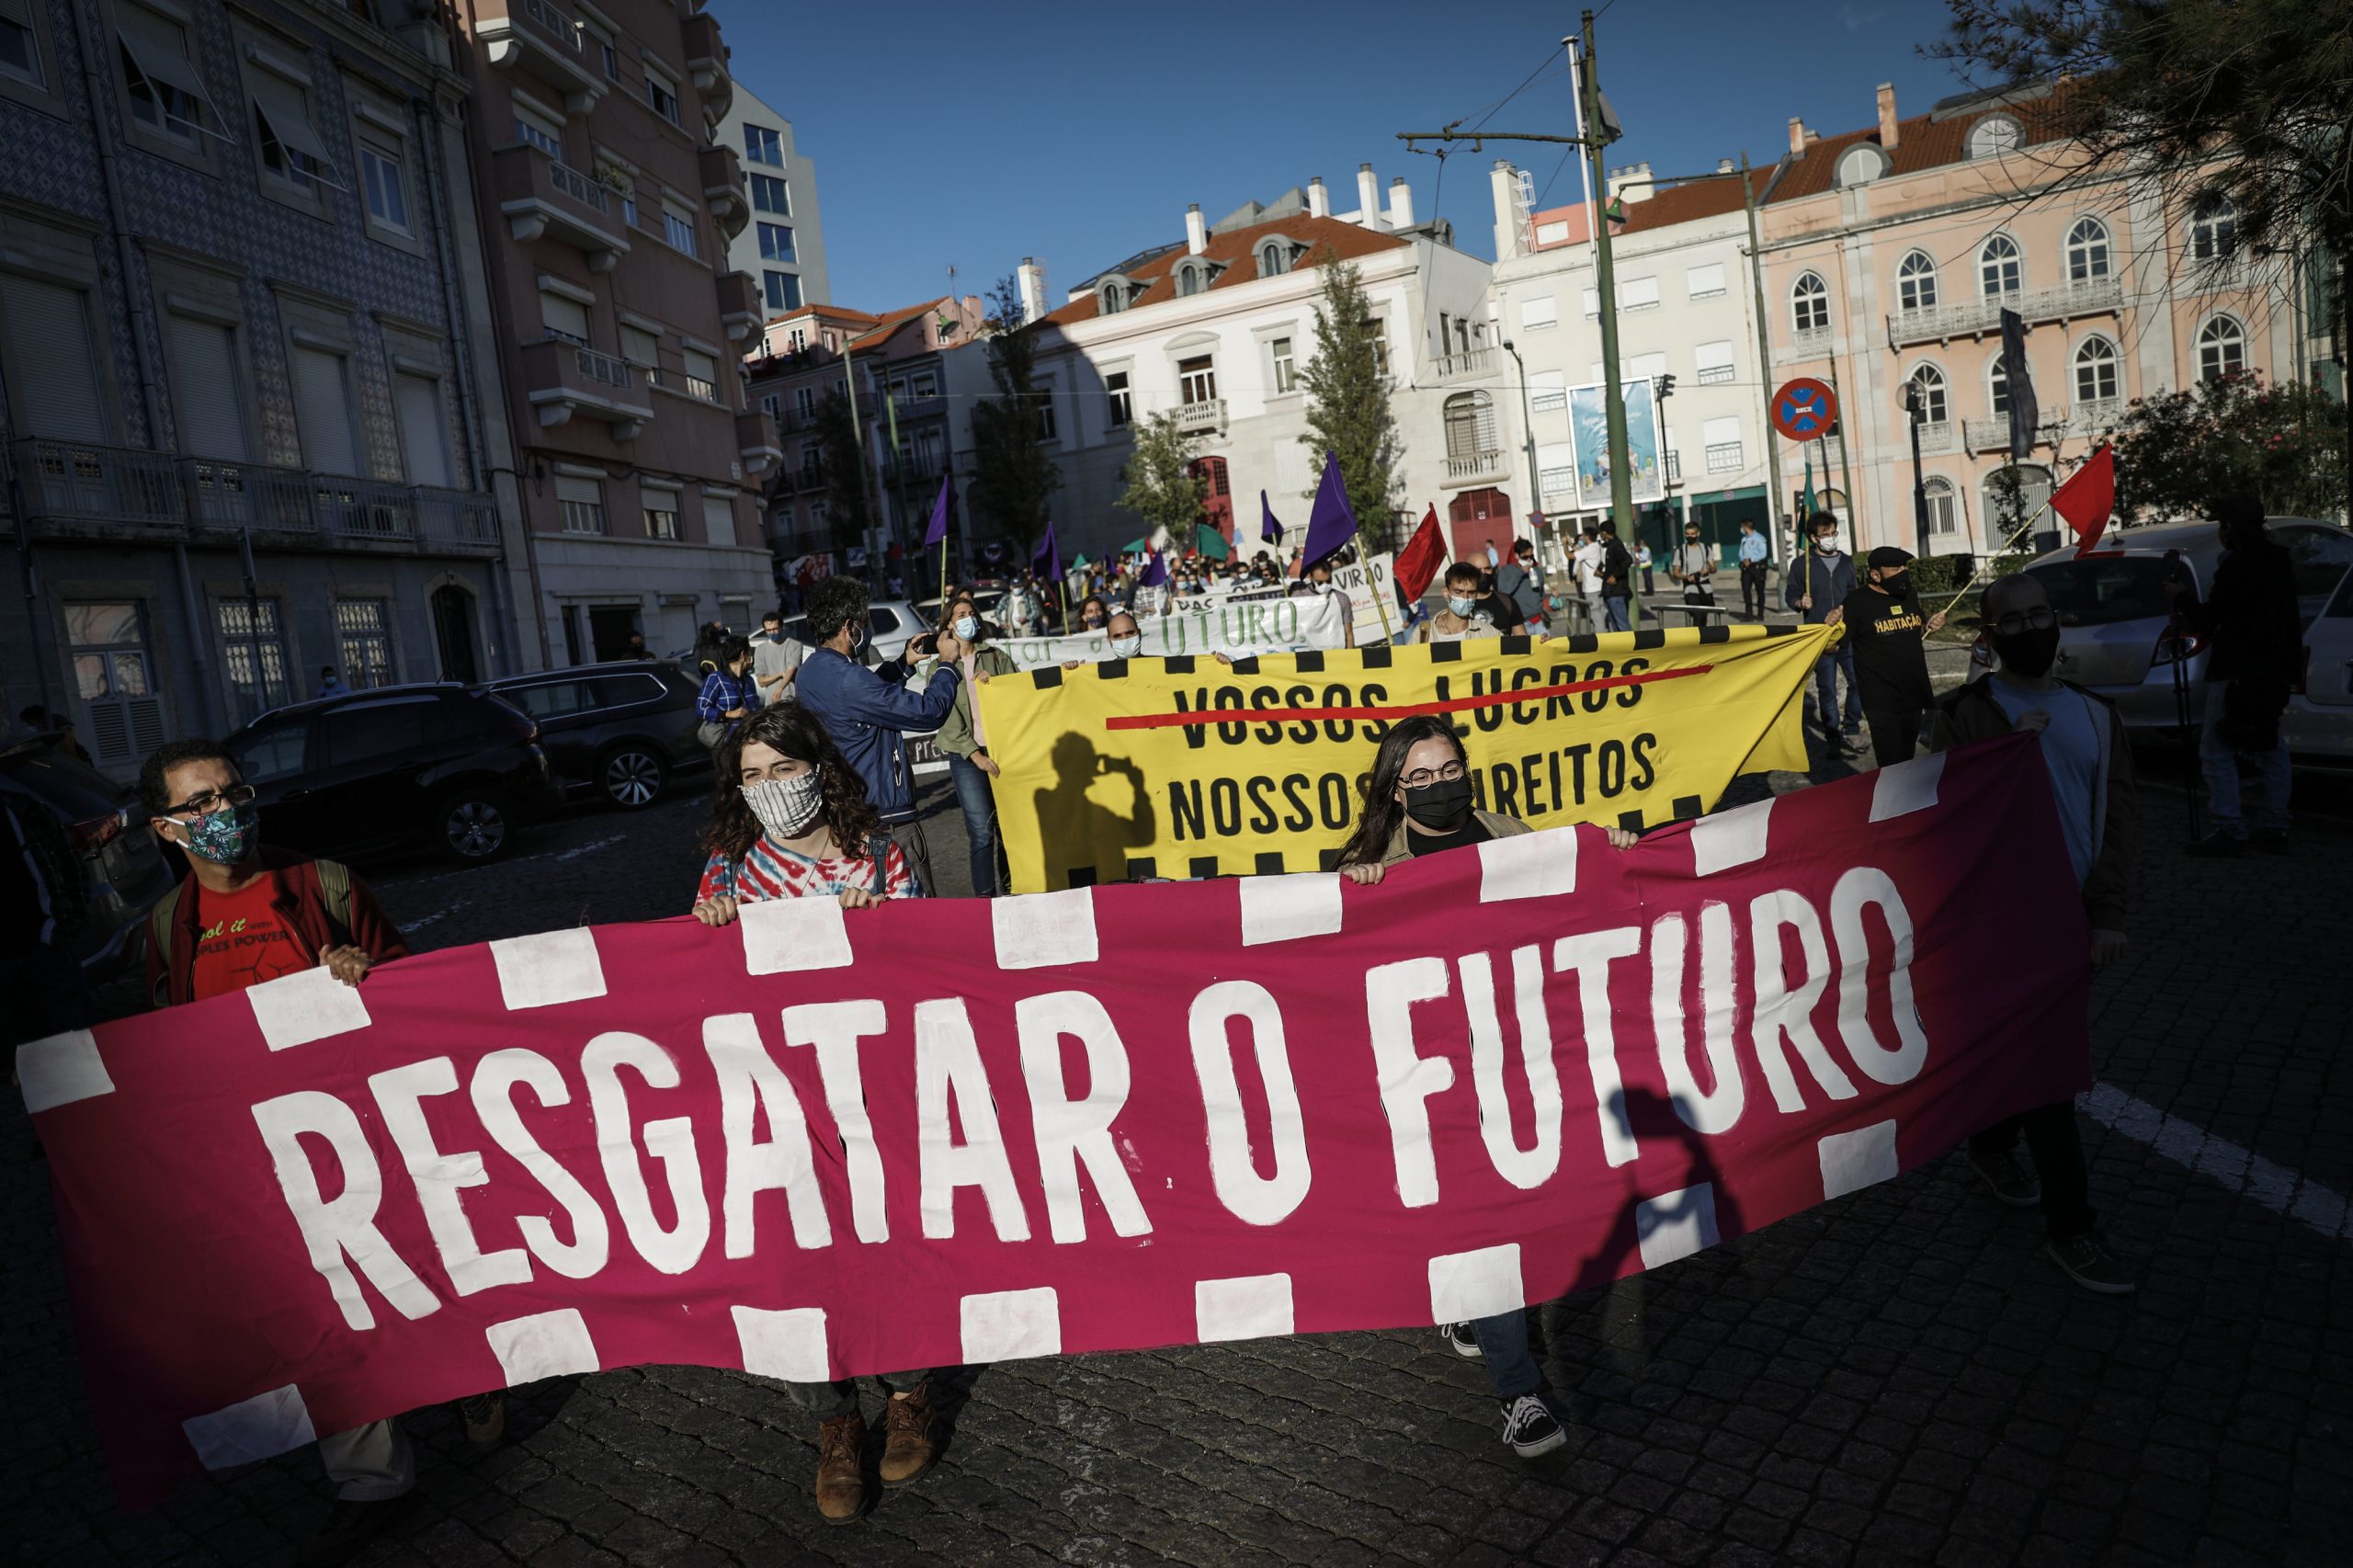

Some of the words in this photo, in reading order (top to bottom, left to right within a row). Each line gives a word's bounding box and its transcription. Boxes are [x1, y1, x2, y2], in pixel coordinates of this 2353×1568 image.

[1335, 562, 1382, 590] VIRO
[1142, 599, 1306, 656] UTURO.
[1874, 613, 1922, 632] HABITAÇÃO
[1173, 683, 1390, 749] VOSSOS
[1434, 657, 1651, 738] LUCROS
[1472, 733, 1657, 821] IREITOS
[234, 930, 291, 949] POWER
[250, 990, 1154, 1332] RESGATAR
[1187, 979, 1313, 1227] O
[1365, 866, 1928, 1209] FUTURO
